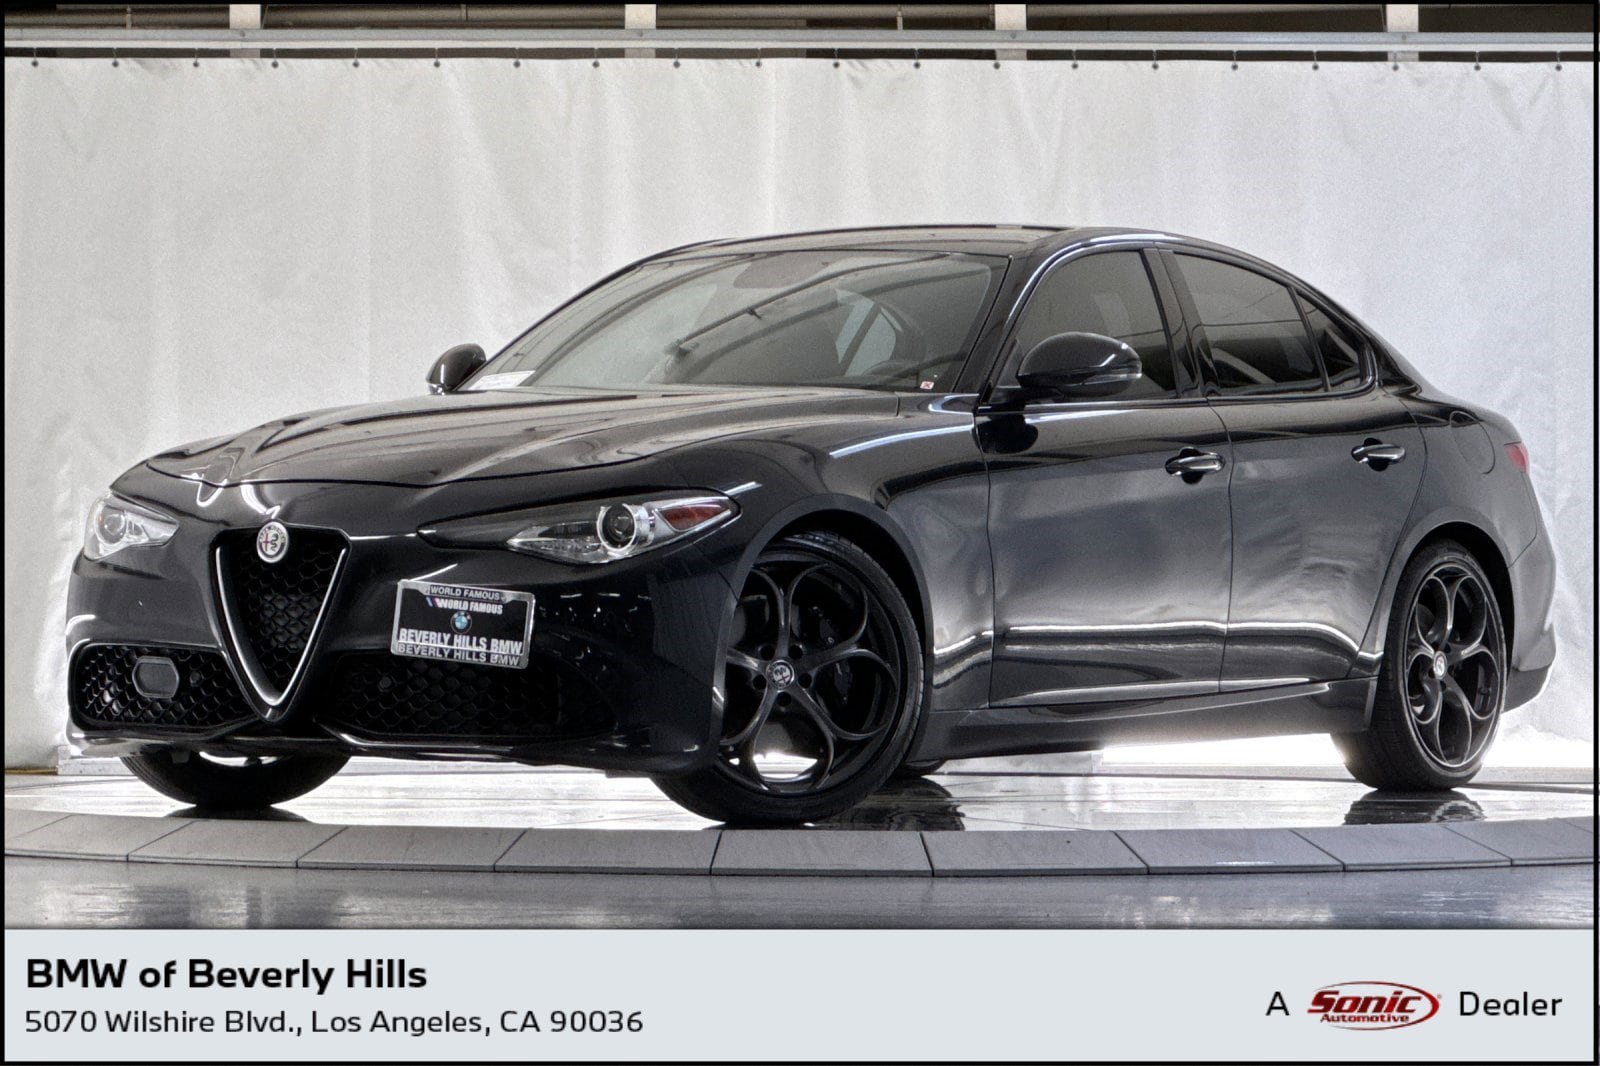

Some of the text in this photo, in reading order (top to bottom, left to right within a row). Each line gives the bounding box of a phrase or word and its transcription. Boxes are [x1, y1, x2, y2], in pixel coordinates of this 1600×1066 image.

[430, 586, 501, 600] WORLD FAMOUS
[436, 598, 503, 615] WORLD FAMOUS
[399, 628, 523, 656] BEVERLY HILLS BMW
[398, 644, 520, 666] BEVERLY HILLS BMW
